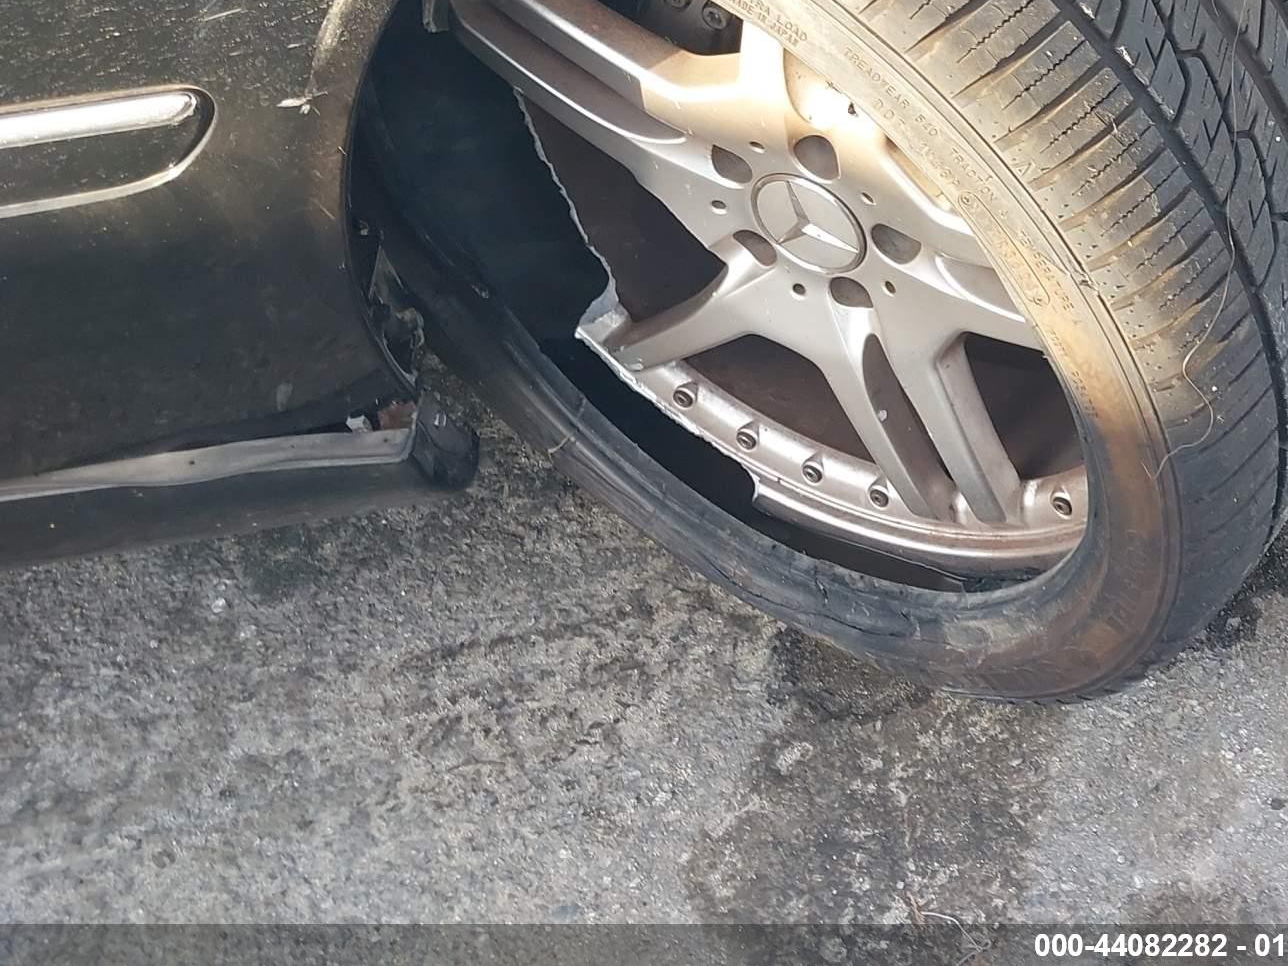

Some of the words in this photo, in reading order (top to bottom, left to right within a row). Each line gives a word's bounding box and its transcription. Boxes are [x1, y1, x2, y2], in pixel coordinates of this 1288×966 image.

[757, 10, 768, 24] IN
[767, 19, 800, 47] JAPAN
[776, 13, 808, 42] LOAD
[951, 146, 997, 204] TRACTON
